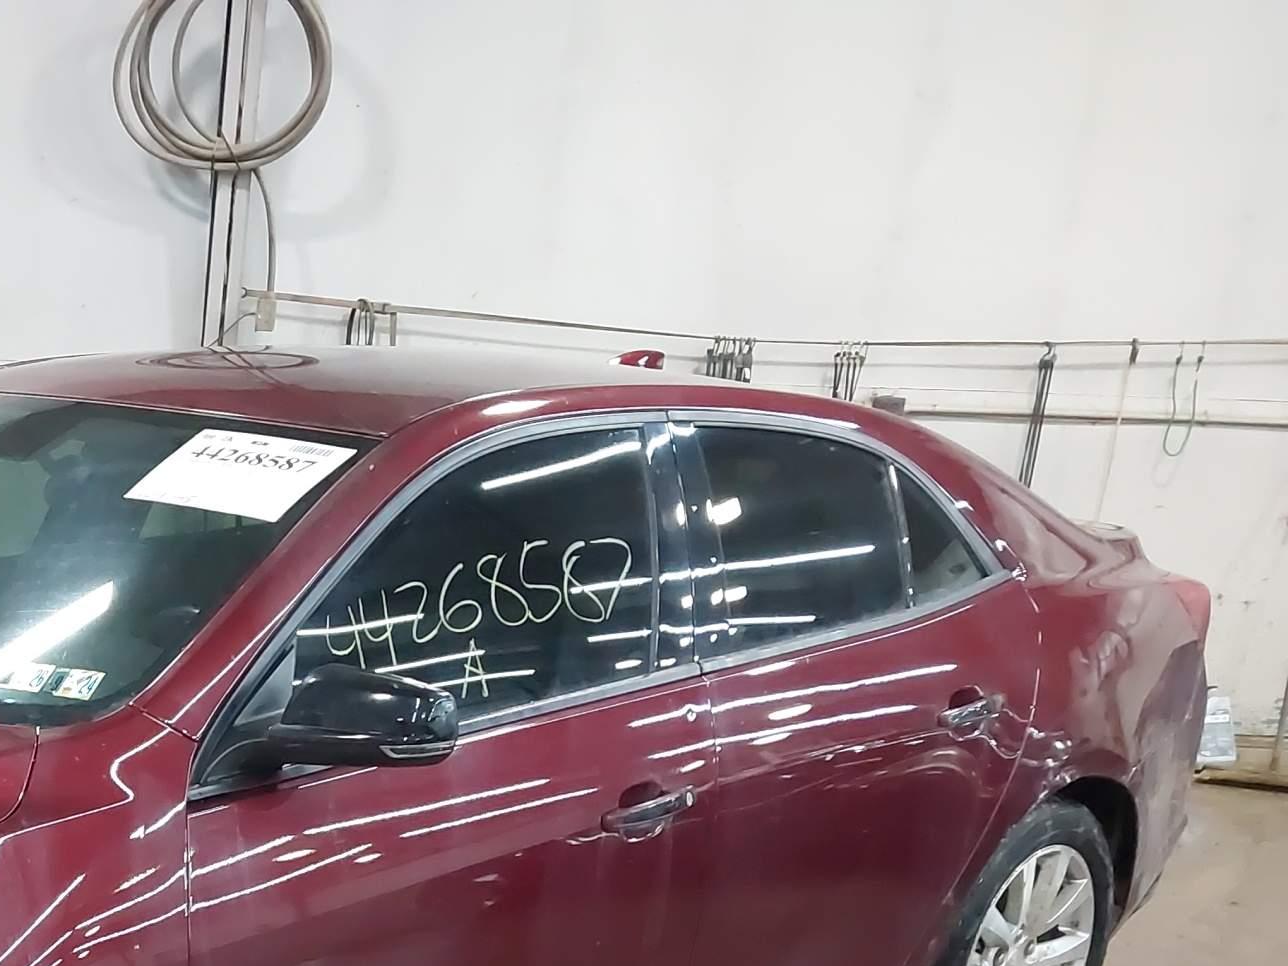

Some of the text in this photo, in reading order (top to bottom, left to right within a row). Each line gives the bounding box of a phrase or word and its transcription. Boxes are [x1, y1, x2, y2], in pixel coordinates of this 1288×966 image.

[191, 445, 317, 473] 44268587
[326, 538, 632, 670] 44268587
[462, 638, 488, 699] A
